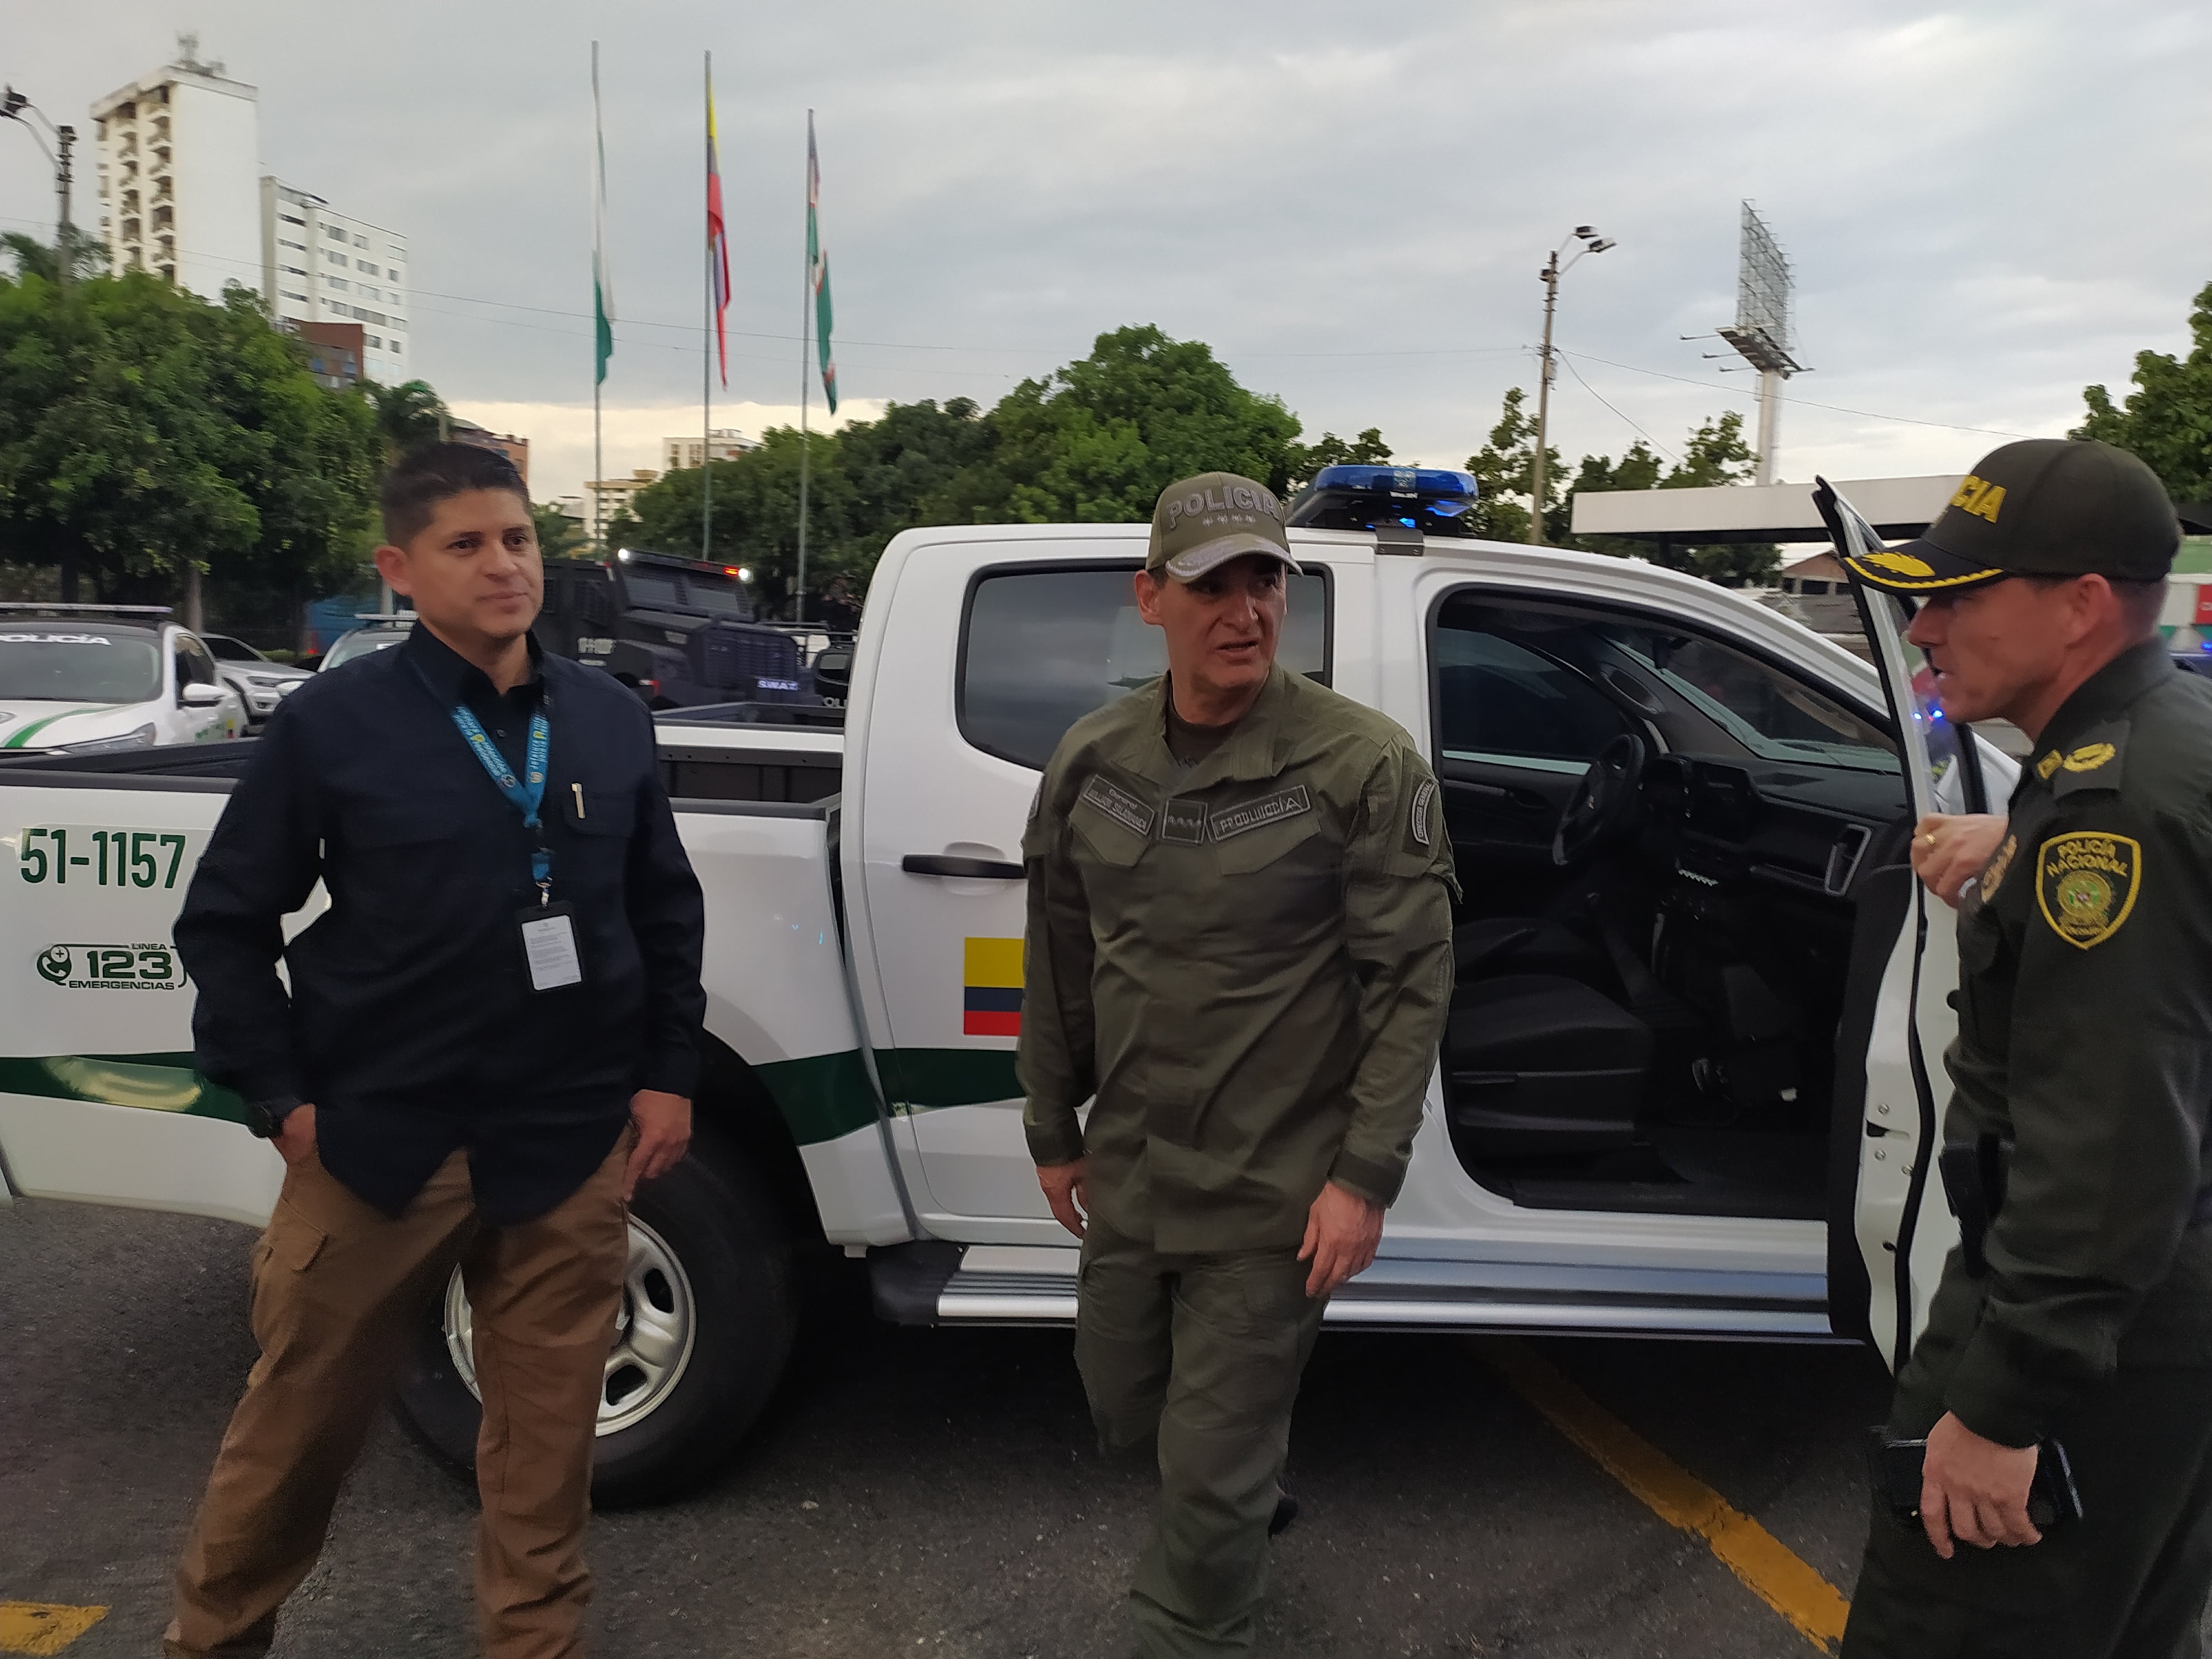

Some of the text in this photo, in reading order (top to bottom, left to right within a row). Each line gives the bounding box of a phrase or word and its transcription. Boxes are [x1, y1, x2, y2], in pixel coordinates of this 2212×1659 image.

[1949, 475, 2007, 523] CIA
[0, 633, 112, 646] OLICÍA
[20, 828, 186, 889] 51-1157
[2046, 854, 2128, 878] NACIONAL
[87, 951, 172, 979] 123
[69, 980, 174, 990] EMERGENCIAS
